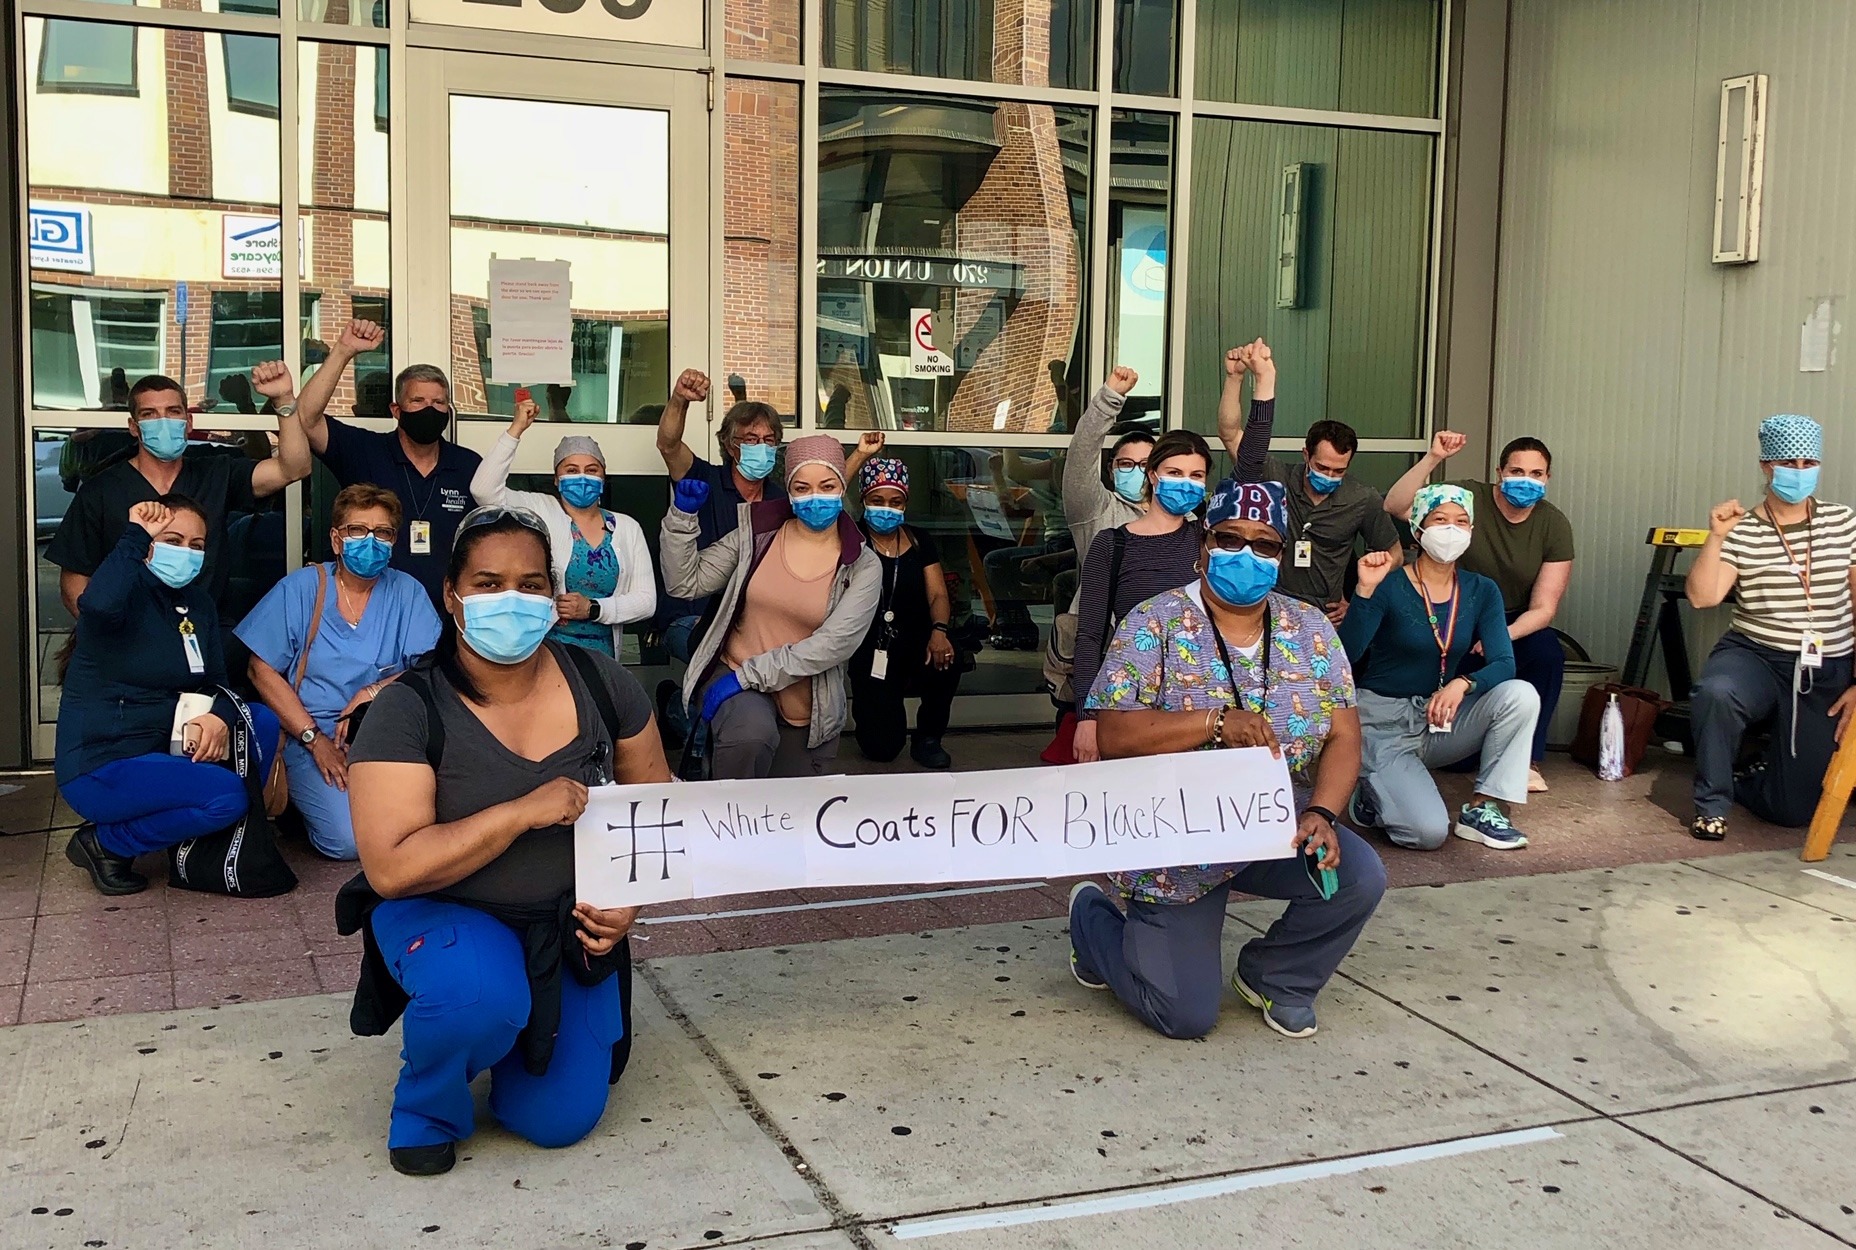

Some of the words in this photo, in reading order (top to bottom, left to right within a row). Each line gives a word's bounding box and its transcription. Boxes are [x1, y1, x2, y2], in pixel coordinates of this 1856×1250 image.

[914, 364, 951, 373] SMOKING
[927, 355, 939, 363] NO
[440, 487, 459, 496] Lynn
[1229, 481, 1275, 525] B
[237, 730, 245, 753] KORS
[701, 801, 794, 841] White
[815, 796, 936, 849] Coats
[951, 796, 1038, 848] FOR
[1179, 787, 1290, 835] LIVES
[226, 866, 237, 888] KORS
